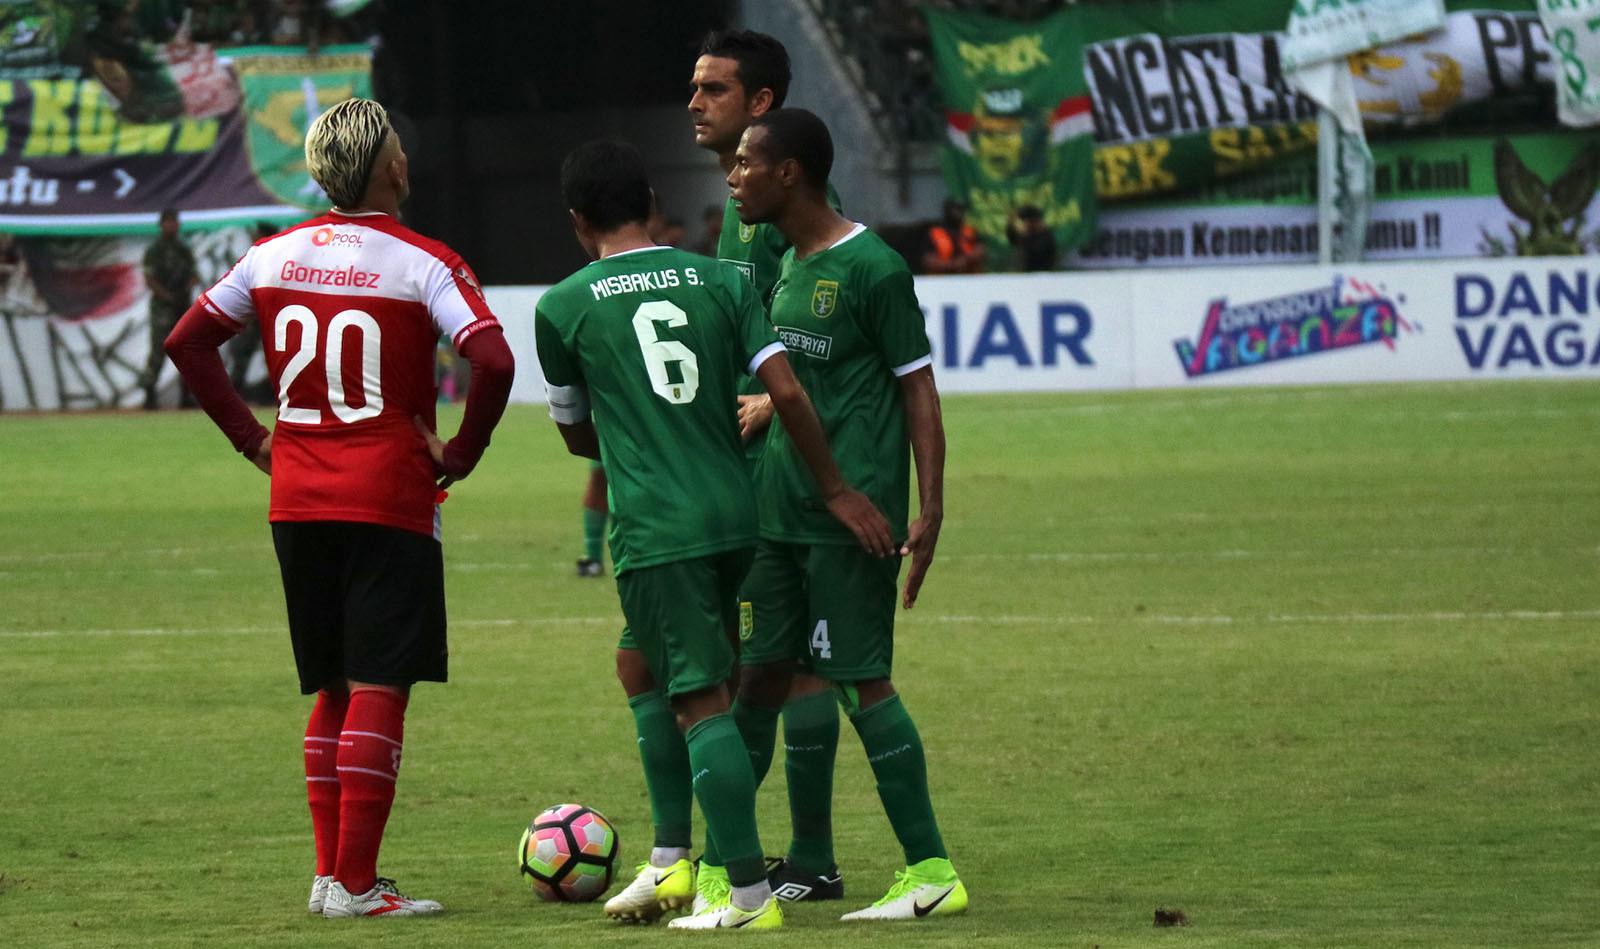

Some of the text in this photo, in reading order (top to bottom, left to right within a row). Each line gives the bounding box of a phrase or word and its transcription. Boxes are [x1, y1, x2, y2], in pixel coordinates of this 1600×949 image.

[281, 260, 381, 289] Gonzalez
[590, 268, 680, 300] MISBAKUS
[685, 267, 704, 286] S.
[1456, 271, 1600, 318] DAN
[632, 300, 699, 404] 6
[780, 331, 827, 355] PERSEBAYA
[928, 302, 1095, 368] IAR
[1455, 321, 1600, 369] VAG
[275, 304, 385, 424] 20
